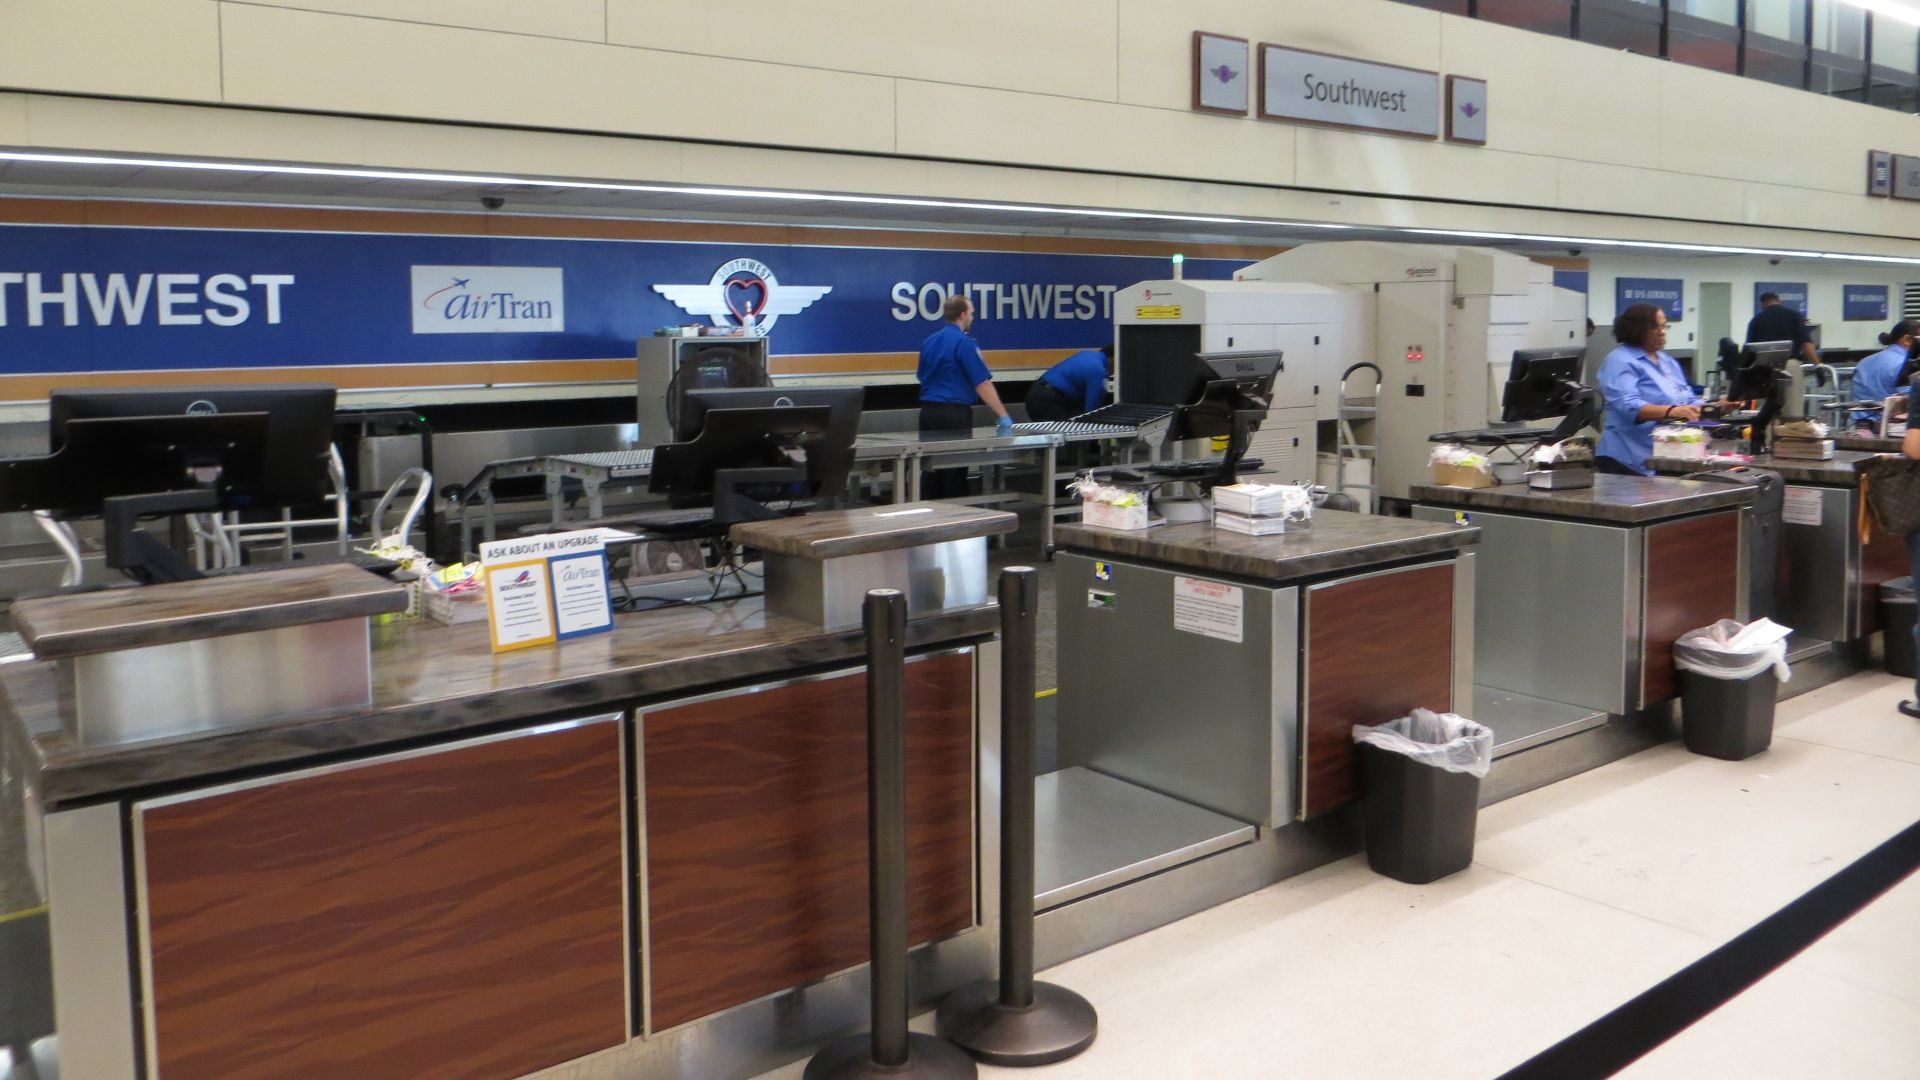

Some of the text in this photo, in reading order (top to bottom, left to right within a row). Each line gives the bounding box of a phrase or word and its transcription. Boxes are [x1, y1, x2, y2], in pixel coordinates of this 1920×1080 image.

[1303, 73, 1406, 112] Southwest
[718, 260, 772, 281] SOUTHWEST
[488, 535, 600, 559] ASK ABOUT AN UPGRADE
